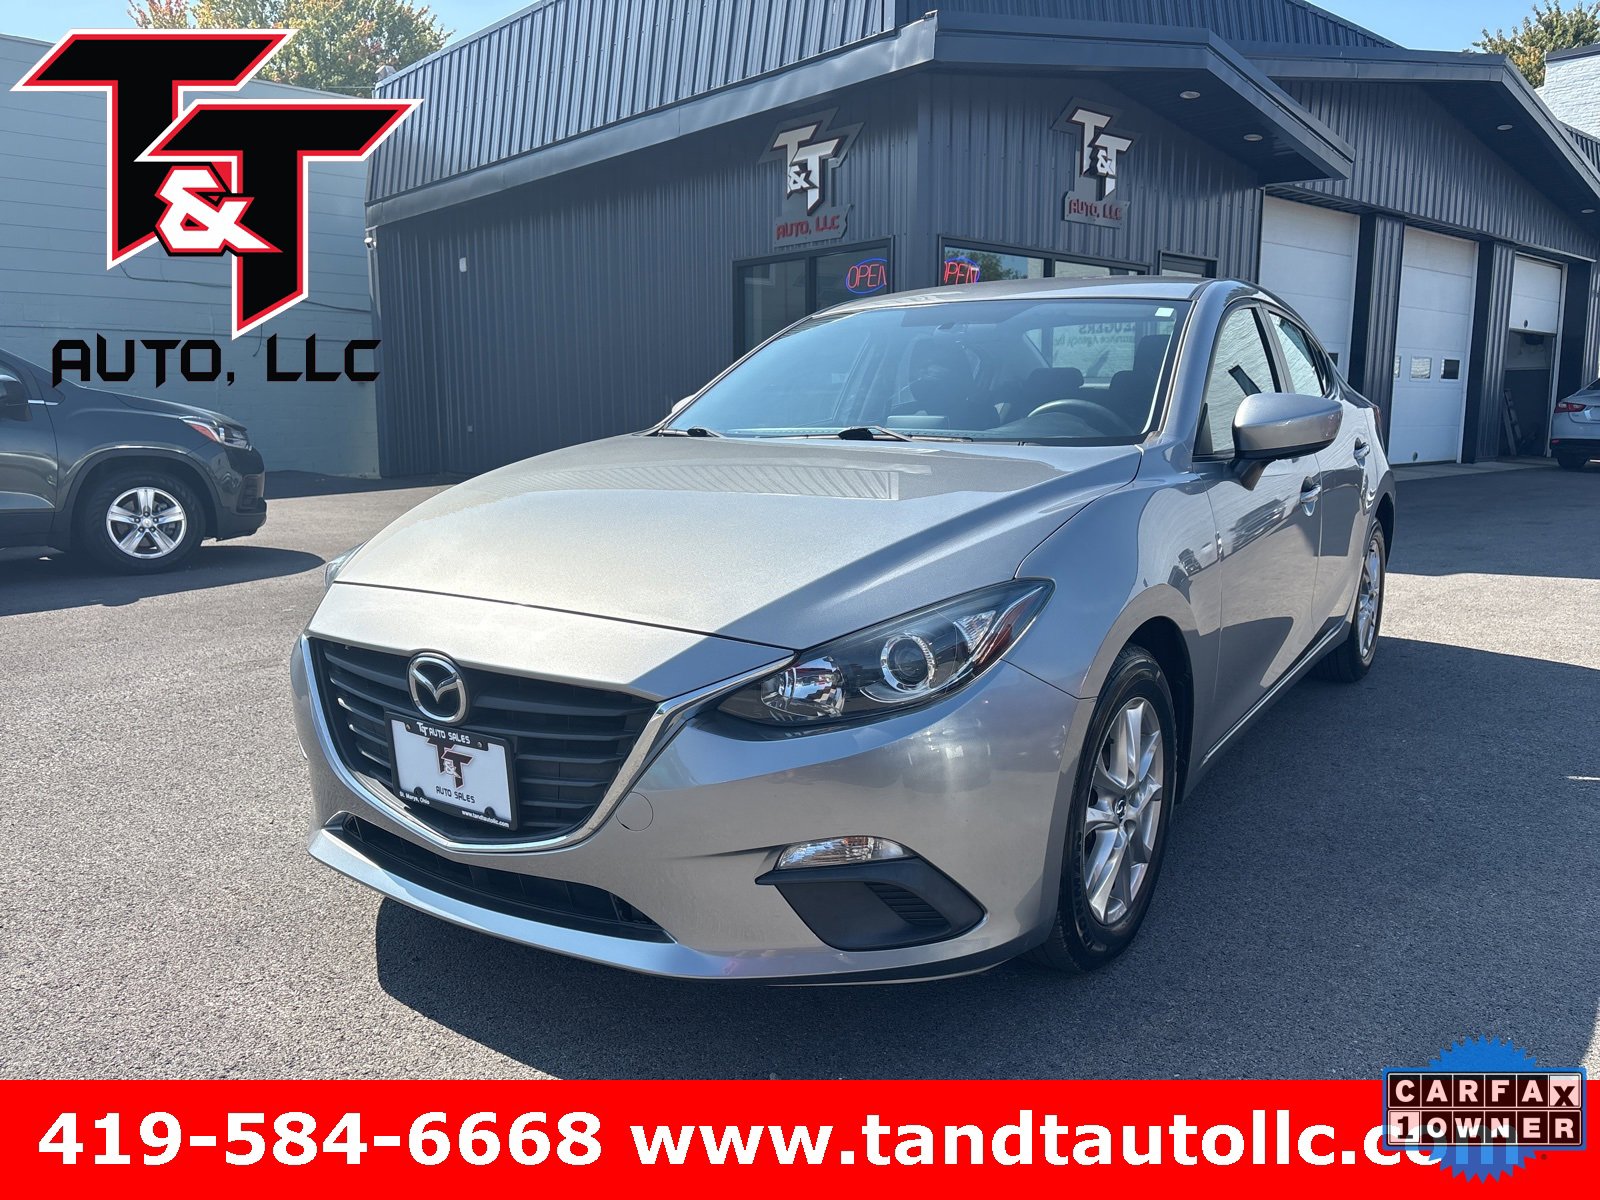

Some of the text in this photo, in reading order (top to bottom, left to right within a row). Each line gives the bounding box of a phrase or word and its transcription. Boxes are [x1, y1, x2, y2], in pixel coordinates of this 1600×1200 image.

[1066, 106, 1134, 200] T&T
[770, 121, 847, 216] T&T
[1068, 199, 1122, 220] AUTO, LLC
[776, 215, 840, 240] AUTO, LLC
[429, 727, 446, 739] AUTO
[447, 731, 471, 745] SALES
[427, 737, 474, 790] T&T
[435, 785, 476, 804] AUTO SALES
